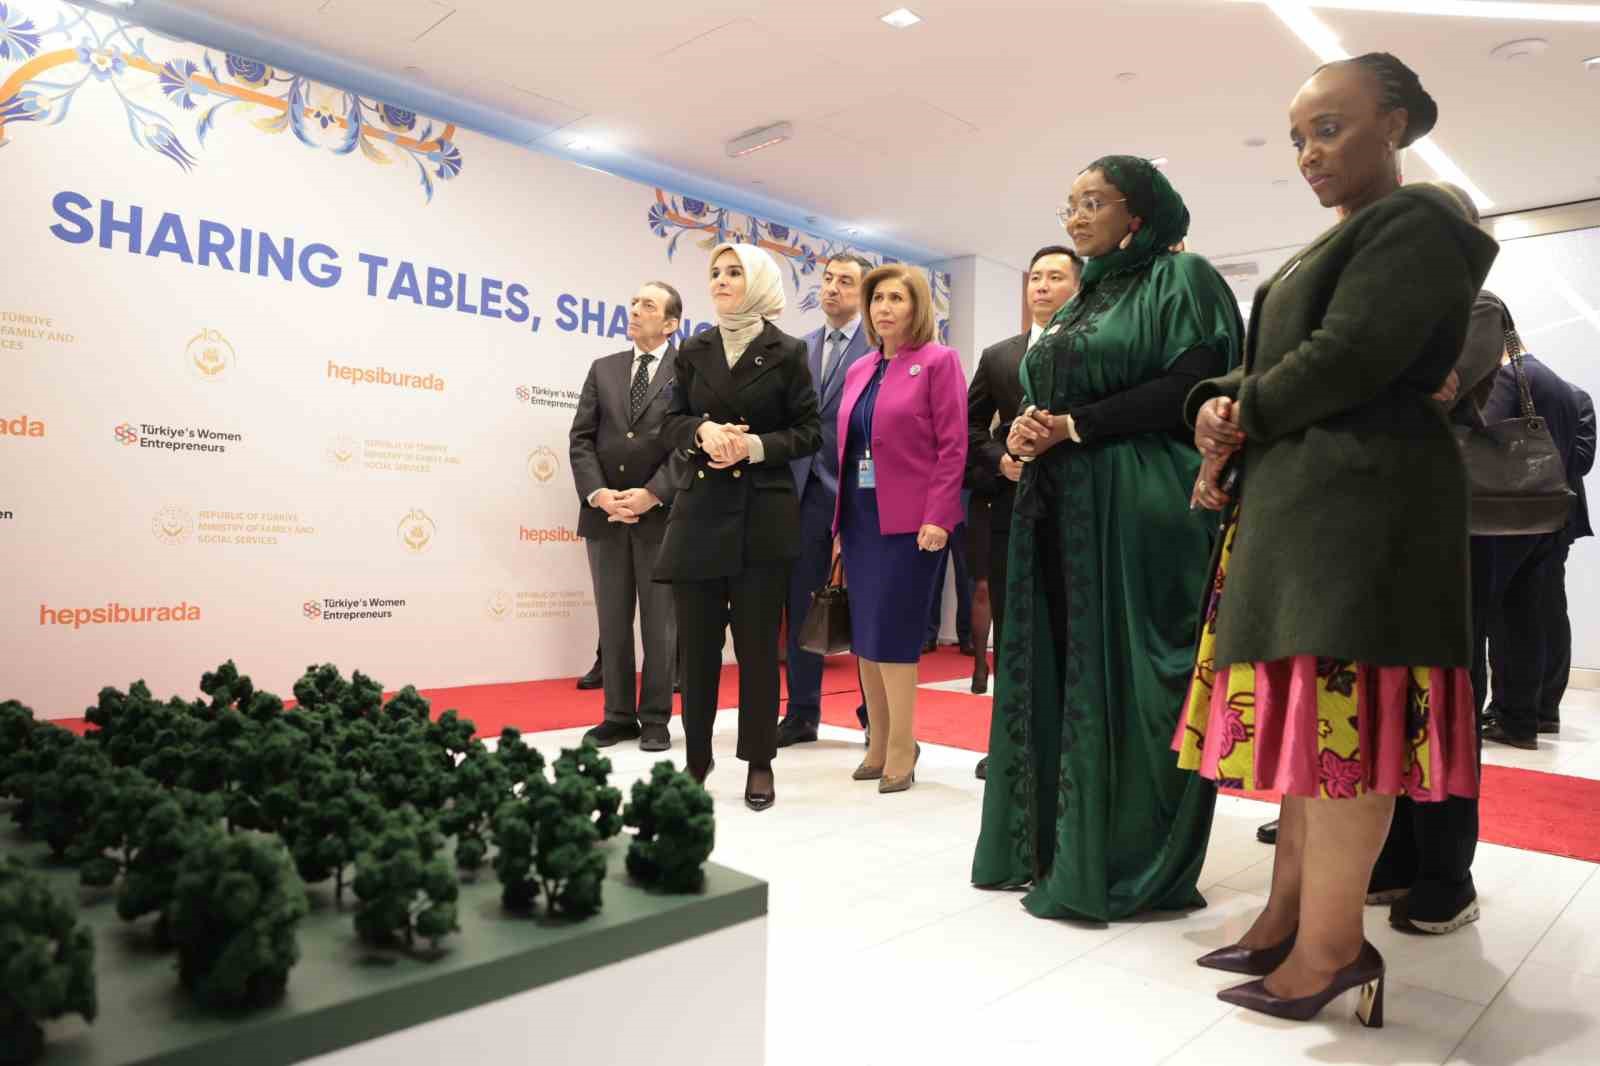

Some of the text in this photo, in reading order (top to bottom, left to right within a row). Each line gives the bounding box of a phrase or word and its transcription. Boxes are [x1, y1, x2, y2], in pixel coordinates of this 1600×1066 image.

[49, 191, 712, 351] SHARING TABLES, SHAN
[47, 331, 75, 343] AND
[327, 360, 445, 391] hepsiburada
[531, 396, 578, 409] Entrepreneu
[141, 424, 242, 441] Türkiye's Women
[140, 438, 225, 452] Entrepreneurs
[235, 535, 278, 544] SERVICES
[519, 525, 582, 545] hepsibu
[323, 598, 405, 609] Türkiye's Women
[40, 602, 200, 629] hepsiburada
[323, 610, 392, 620] Entrepreneurs
